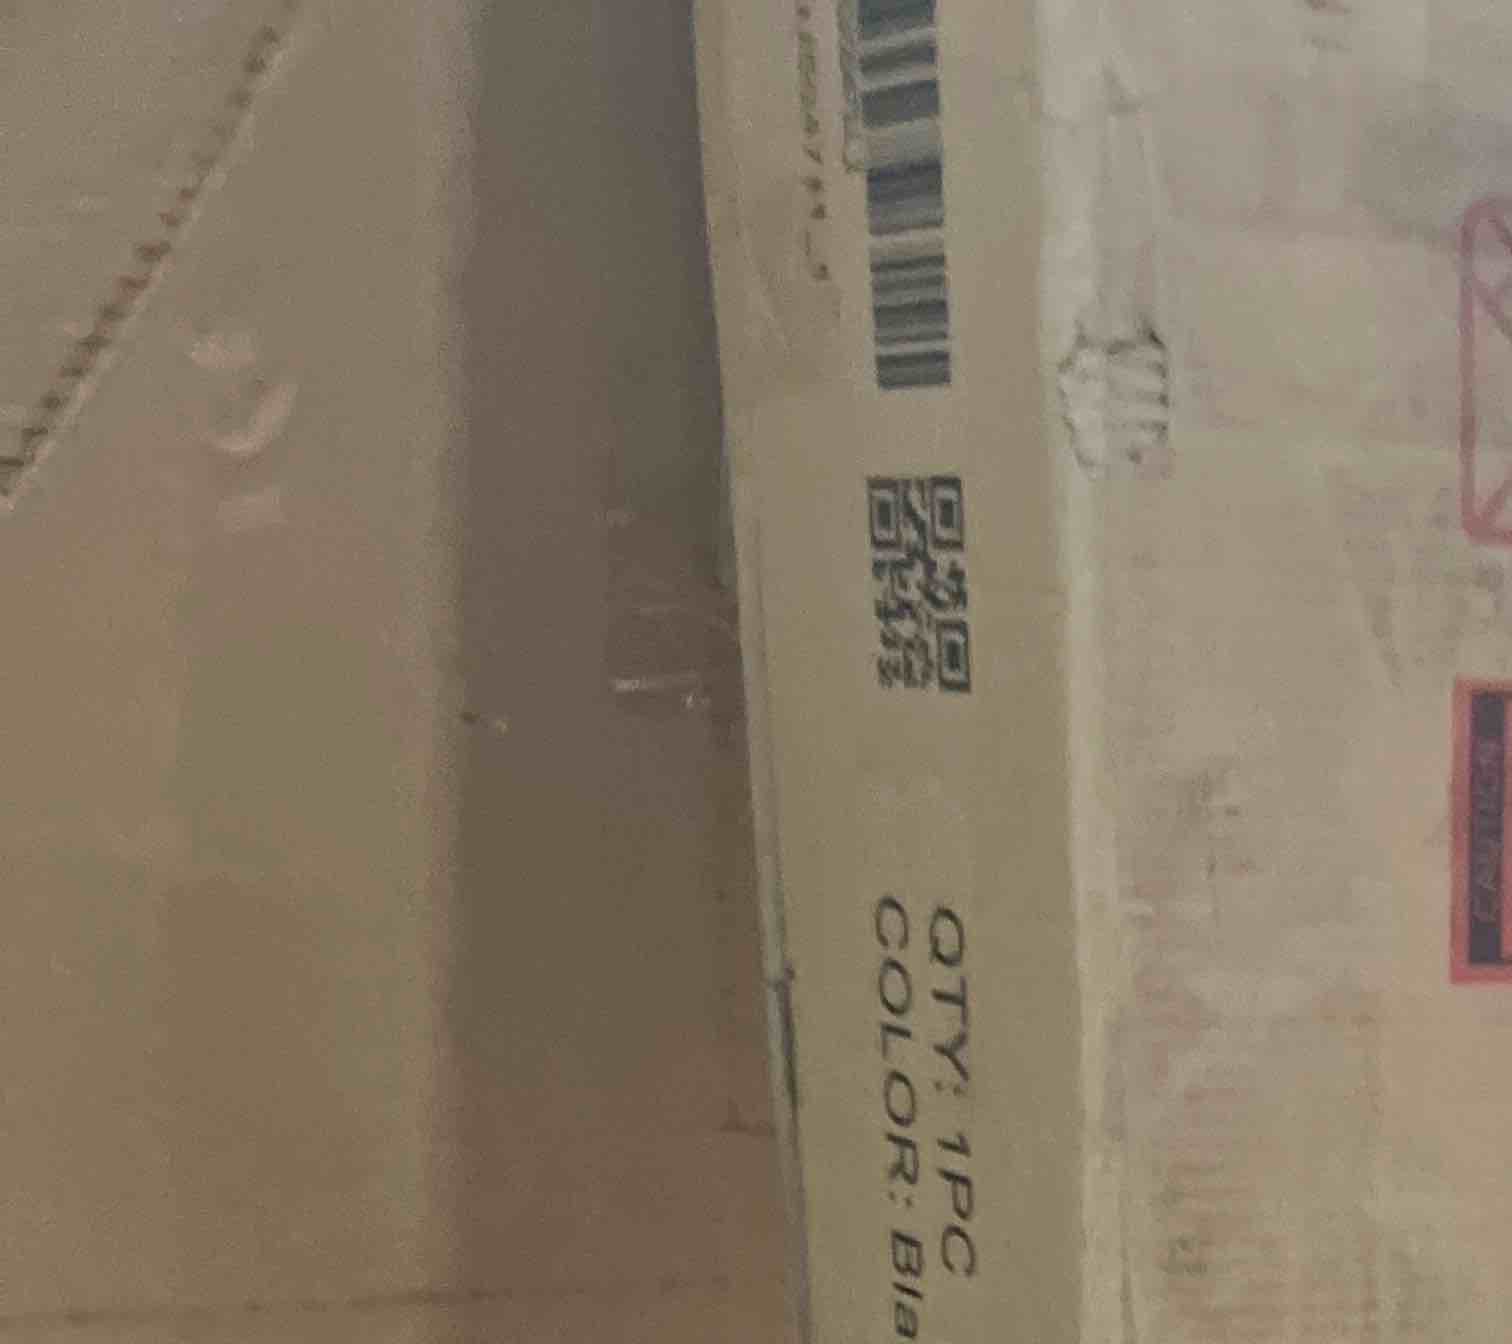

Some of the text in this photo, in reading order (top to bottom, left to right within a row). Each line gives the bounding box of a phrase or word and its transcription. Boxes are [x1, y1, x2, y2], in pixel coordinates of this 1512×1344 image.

[875, 896, 919, 1208] COLOR:
[929, 904, 977, 1278] QTY: 1PC
